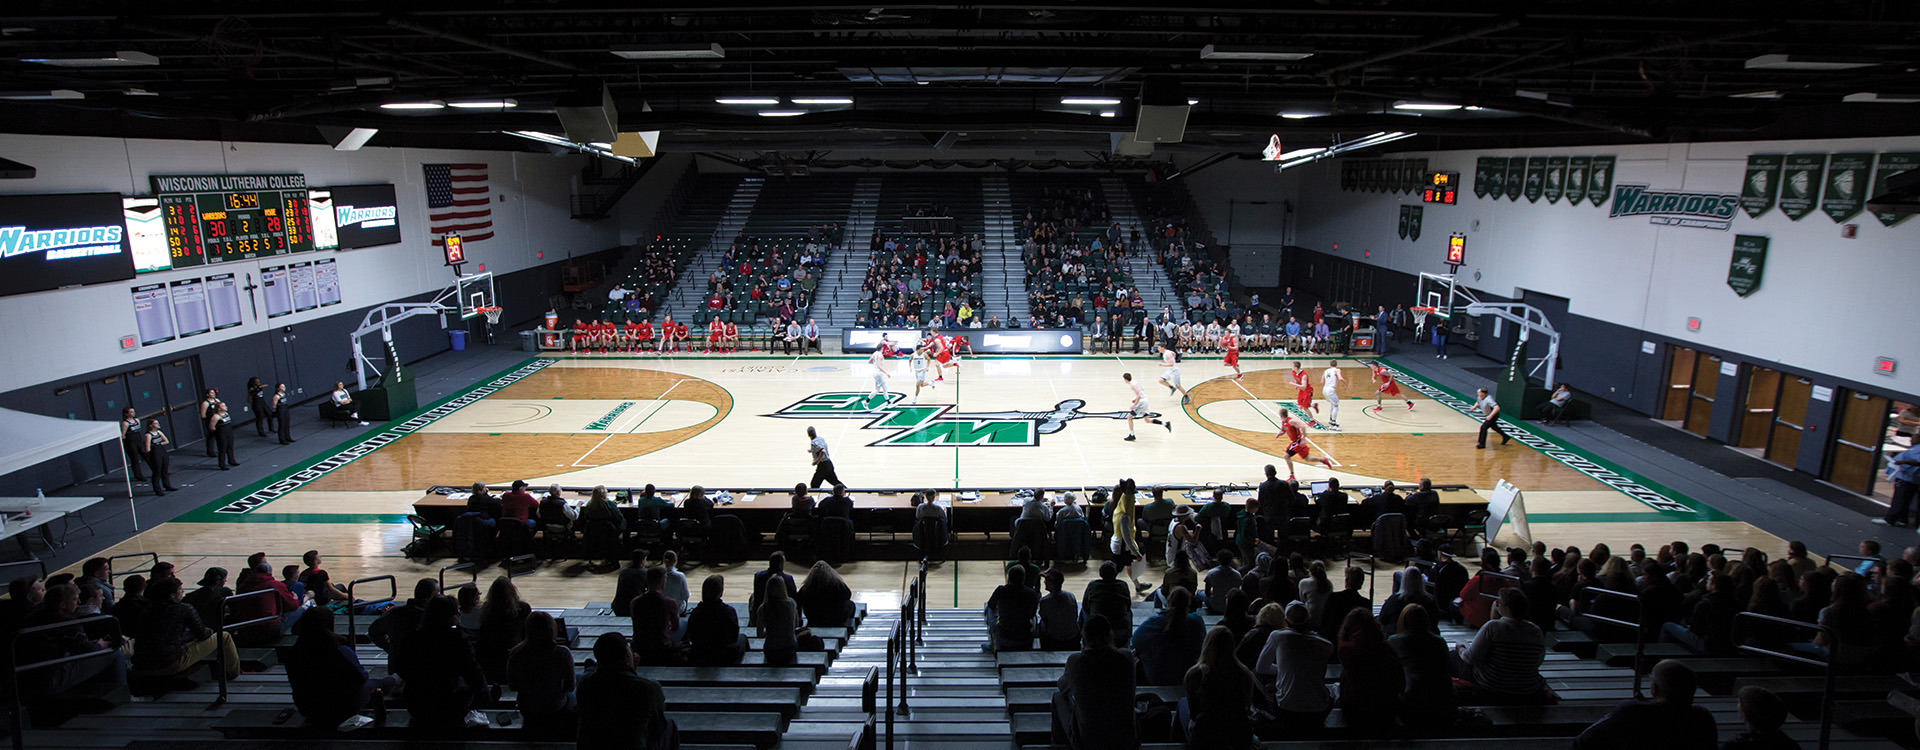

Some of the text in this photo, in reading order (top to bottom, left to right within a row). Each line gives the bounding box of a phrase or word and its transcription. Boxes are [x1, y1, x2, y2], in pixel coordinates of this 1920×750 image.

[158, 176, 305, 191] WISCONSIN LUTHERAN COLLEGE
[229, 193, 258, 208] 16:44
[1610, 184, 1740, 219] WARRIORS
[169, 205, 195, 215] 3 2 2
[286, 209, 294, 217] 23
[336, 204, 396, 228] WARRIORS
[178, 216, 184, 225] 0
[191, 215, 197, 224] 6
[243, 220, 249, 233] 2
[267, 217, 281, 232] 28
[180, 226, 186, 235] 2
[192, 225, 198, 234] 6
[210, 221, 226, 237] 30
[0, 226, 122, 258] WARRIORS
[169, 237, 181, 247] 50
[216, 236, 284, 254] 1 5 25 2 5 3
[46, 244, 122, 260] BASKETBALL
[172, 247, 183, 258] 33
[448, 246, 461, 261] 29
[1450, 246, 1462, 261] 29
[487, 358, 556, 387] COLLEGE
[390, 386, 499, 432] LUTHERAN
[582, 401, 636, 431] WARRIORS
[214, 432, 402, 514] WISCONSIN
[1546, 450, 1698, 513] COLLEGE
